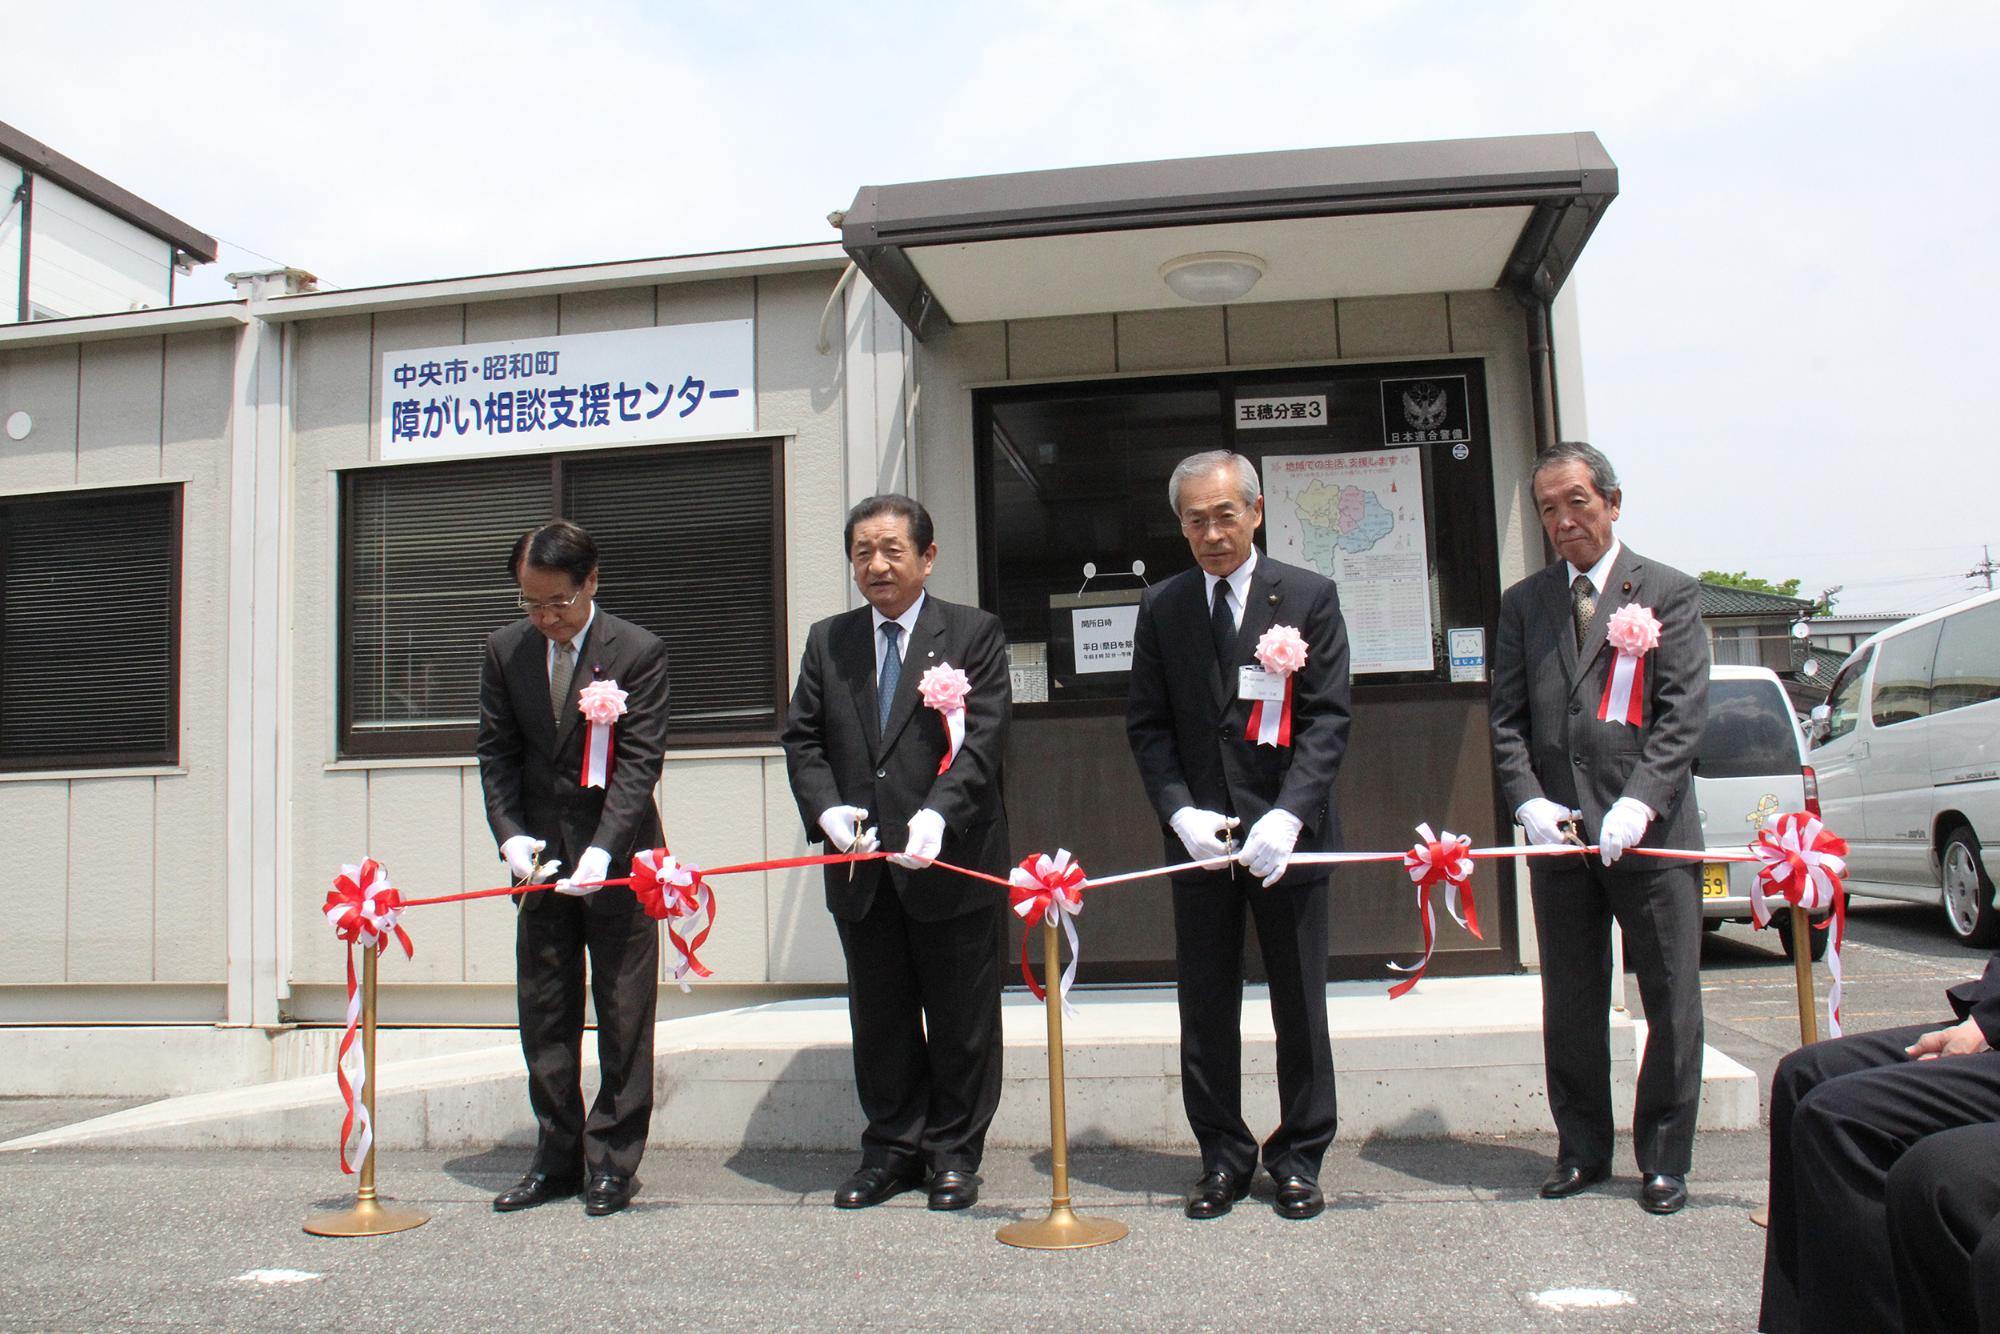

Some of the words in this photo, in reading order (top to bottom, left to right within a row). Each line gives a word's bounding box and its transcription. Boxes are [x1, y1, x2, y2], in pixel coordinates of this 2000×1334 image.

[394, 350, 560, 389] 中央市・昭和町
[391, 375, 740, 444] 障がい相談支援センター
[1240, 401, 1321, 421] 玉穂分室3
